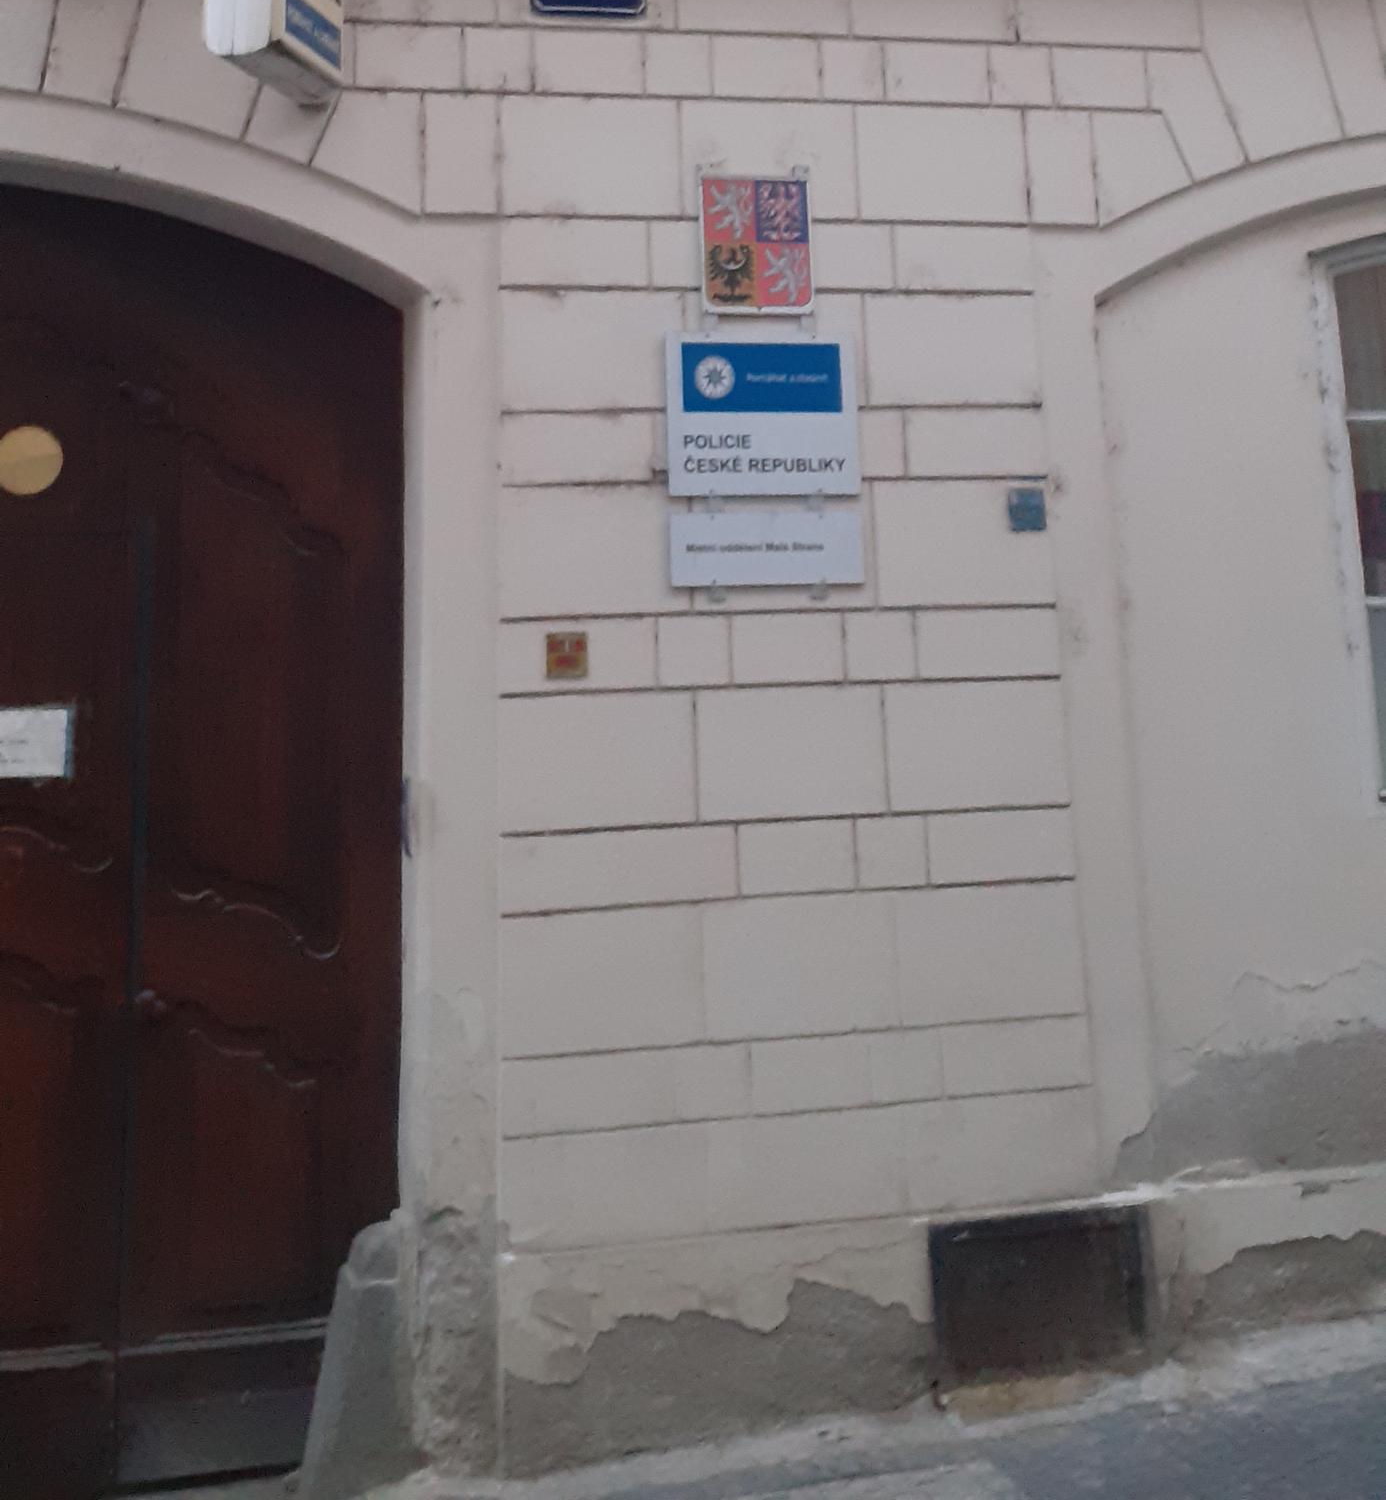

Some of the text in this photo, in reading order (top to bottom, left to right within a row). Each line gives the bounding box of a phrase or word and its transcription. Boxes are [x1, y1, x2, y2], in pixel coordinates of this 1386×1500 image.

[683, 434, 752, 450] POLICIE
[684, 455, 847, 473] ČESKÉ REPUBLIKY
